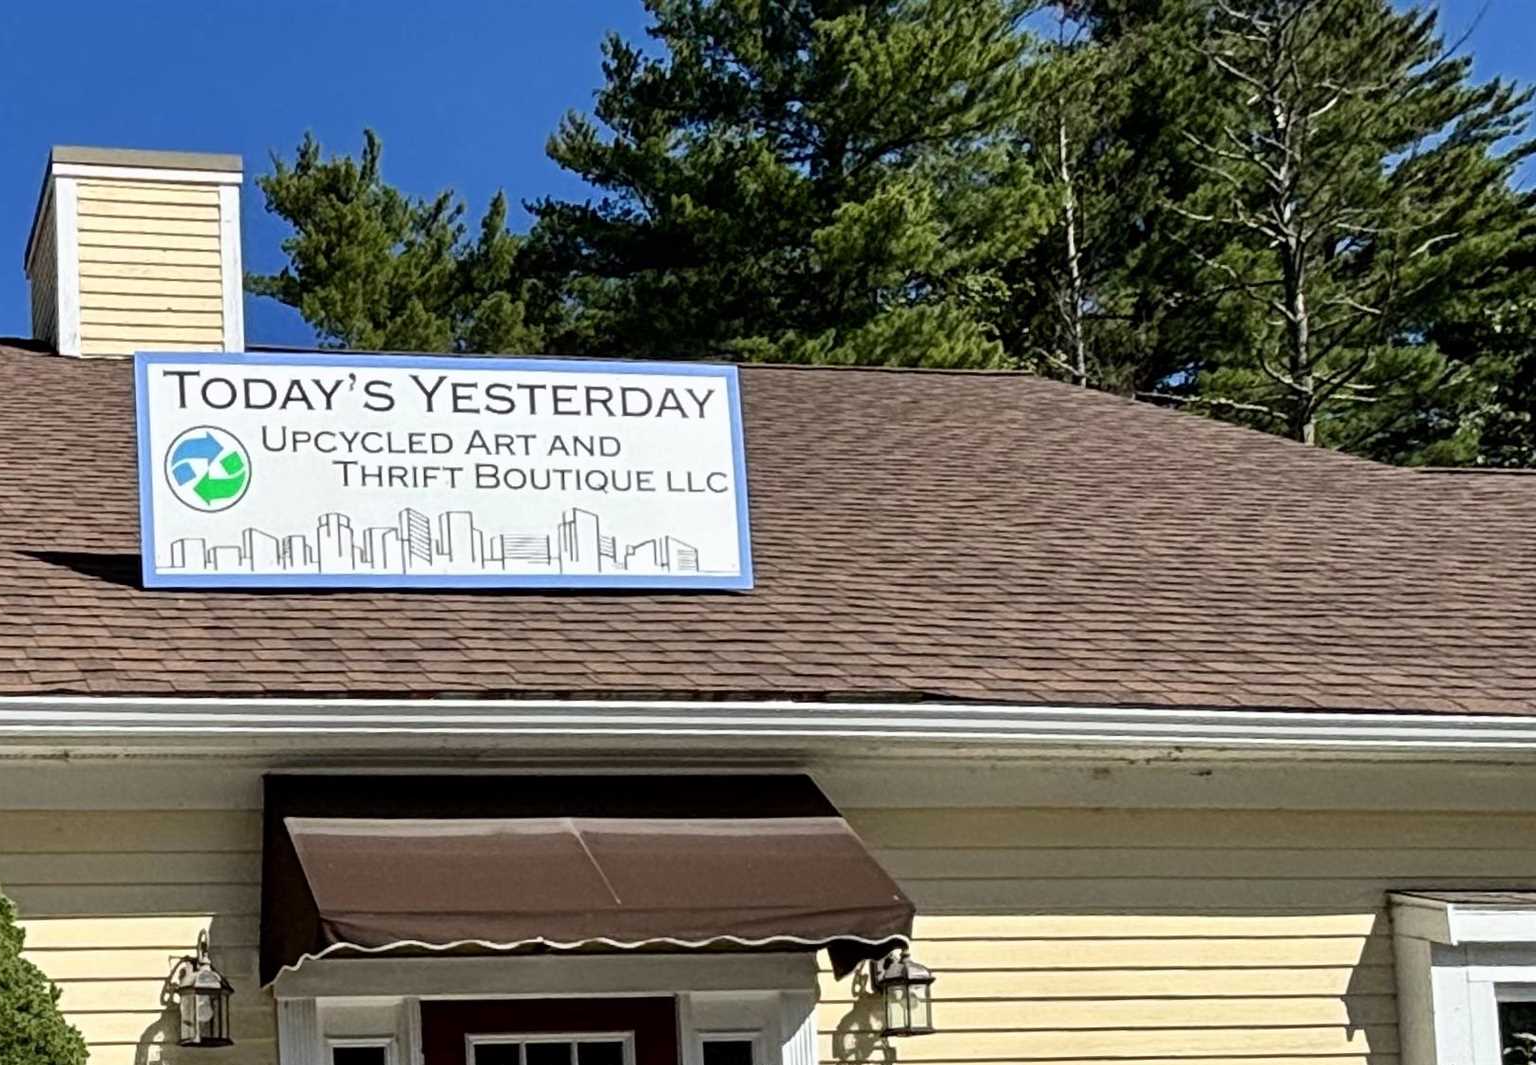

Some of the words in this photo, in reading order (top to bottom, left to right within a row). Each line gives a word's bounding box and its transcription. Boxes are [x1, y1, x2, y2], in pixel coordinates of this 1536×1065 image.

[163, 371, 395, 412] TODAY'S
[409, 374, 715, 419] YESTERDAY
[261, 425, 454, 455] UPCYCLED
[464, 429, 537, 456] ART
[547, 435, 621, 457] AND
[332, 460, 464, 489] THRIFT
[475, 463, 656, 494] BOUTIQUE
[666, 471, 728, 494] LLC
